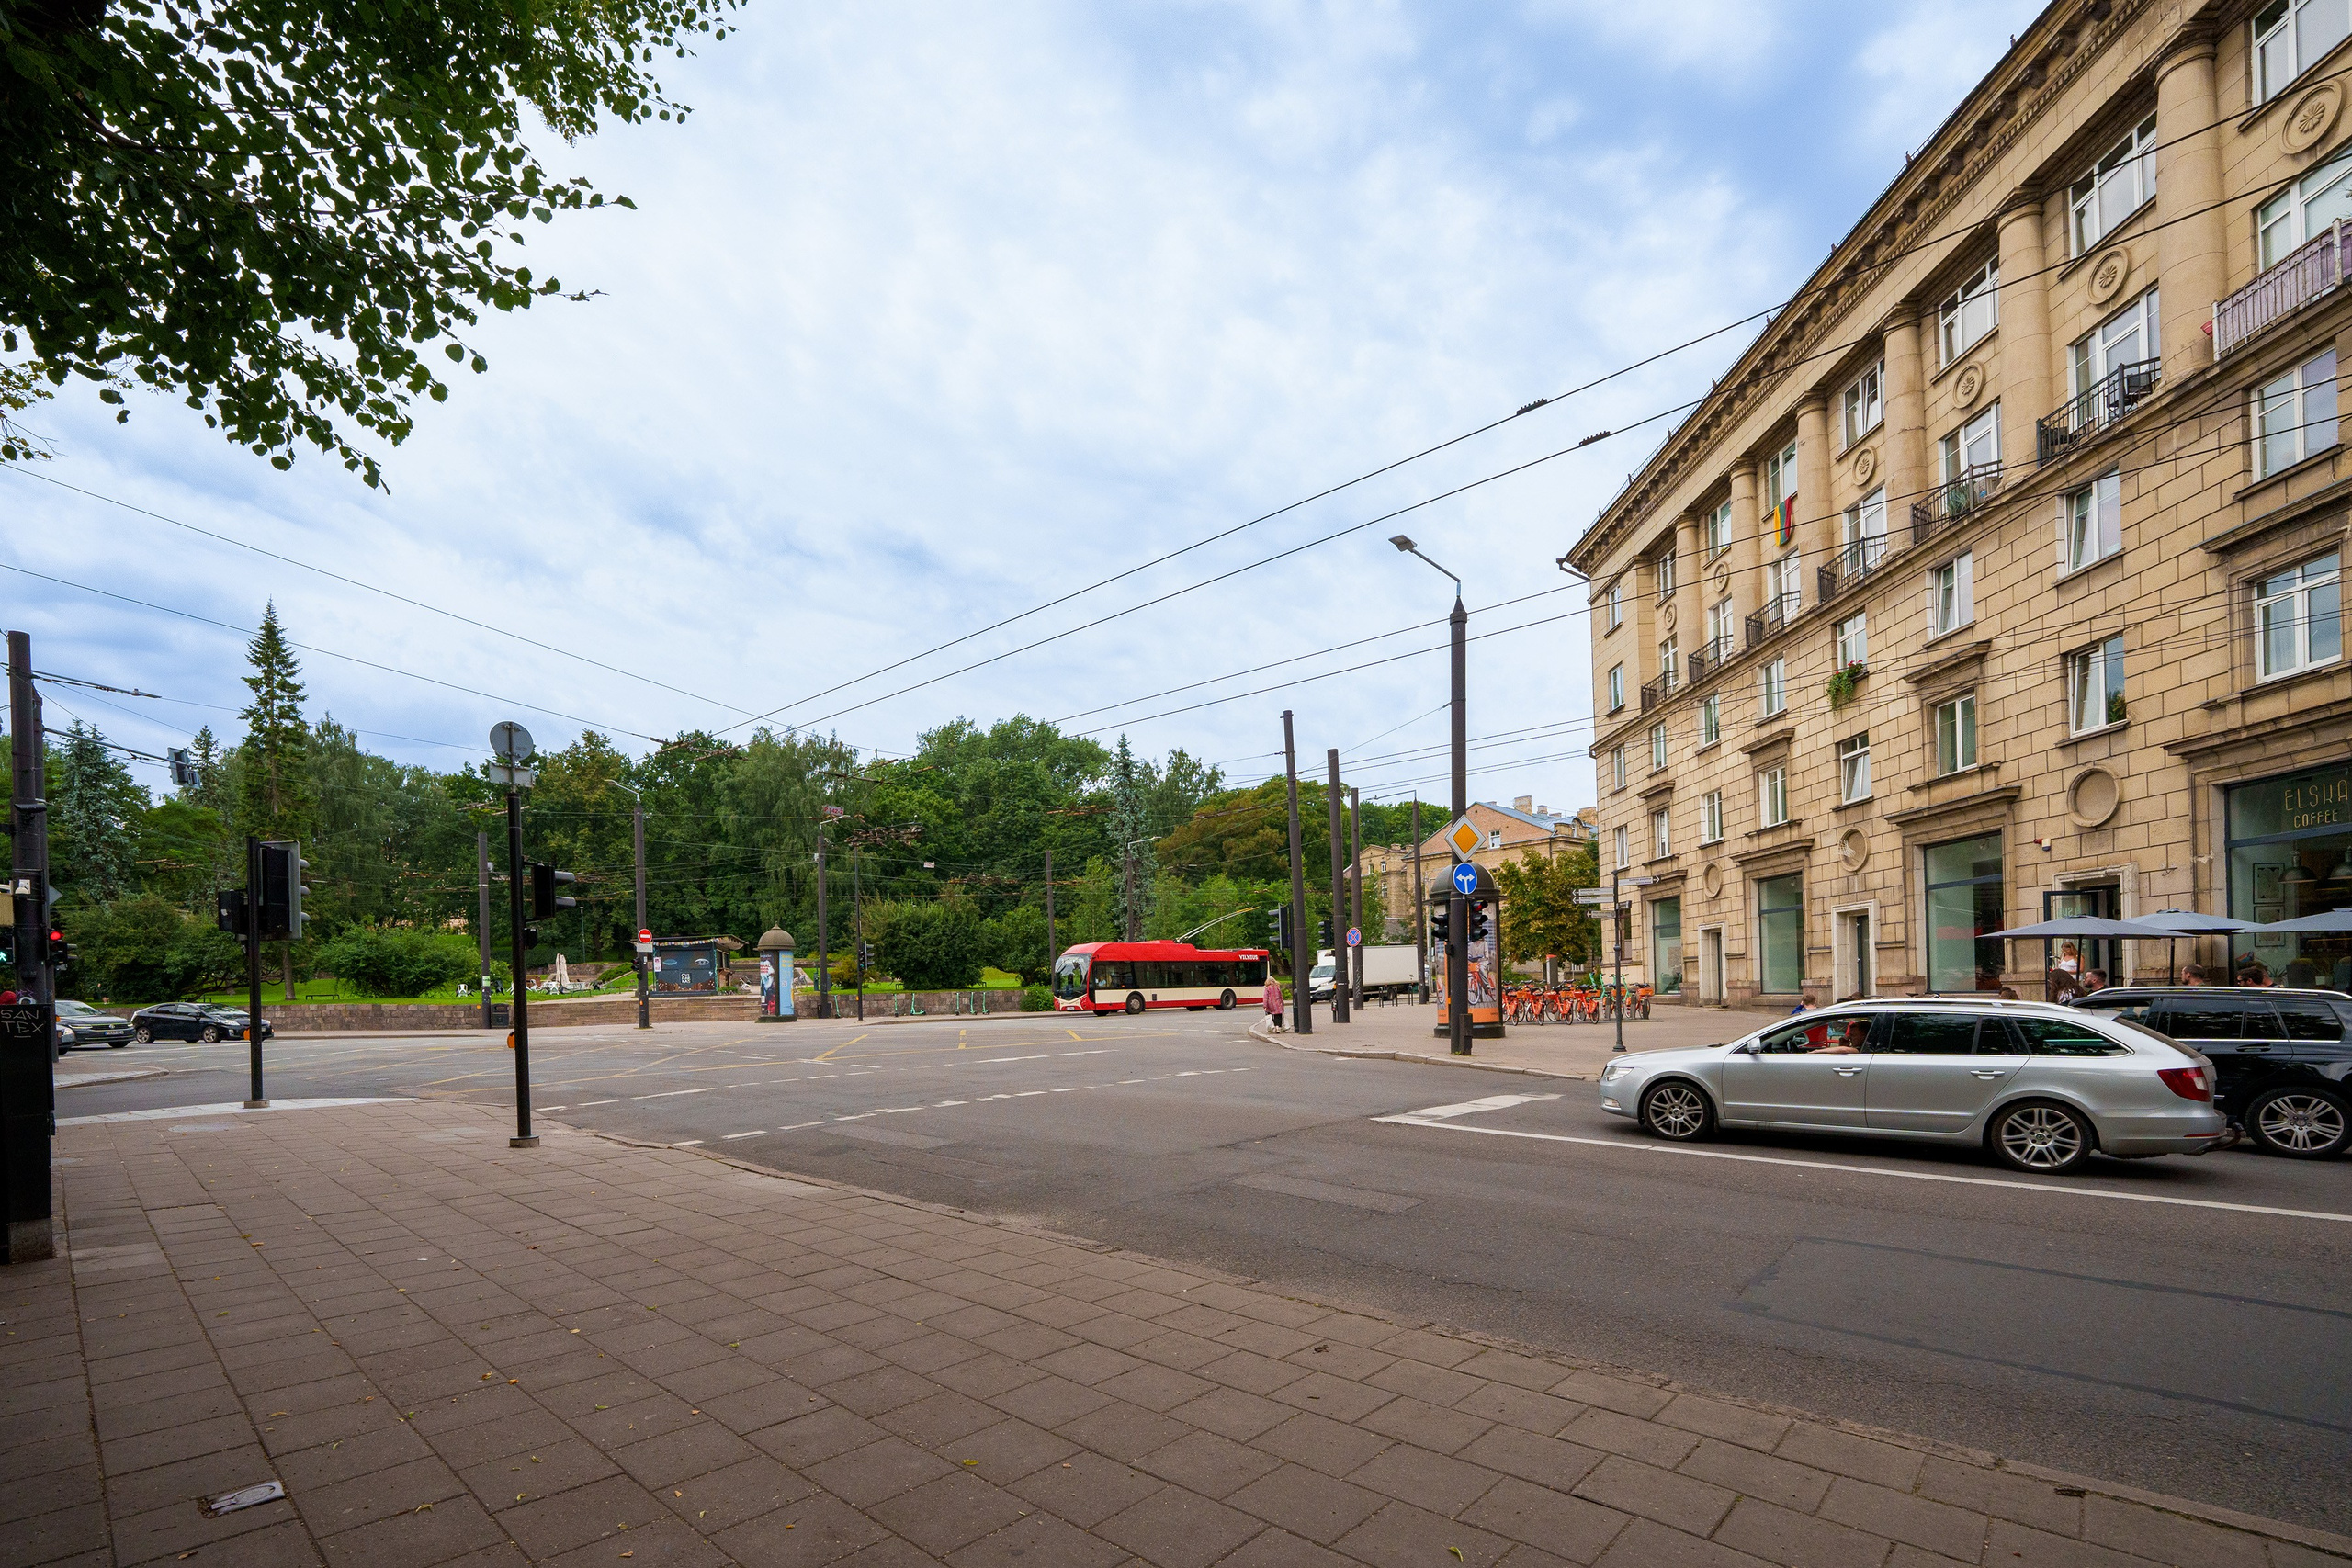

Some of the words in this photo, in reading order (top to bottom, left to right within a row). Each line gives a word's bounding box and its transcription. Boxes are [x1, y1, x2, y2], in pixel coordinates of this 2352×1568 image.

[2284, 779, 2348, 811] ELSKA
[2293, 809, 2338, 829] COFFEE
[0, 1009, 40, 1020] SAN
[1, 1021, 44, 1033] TEX
